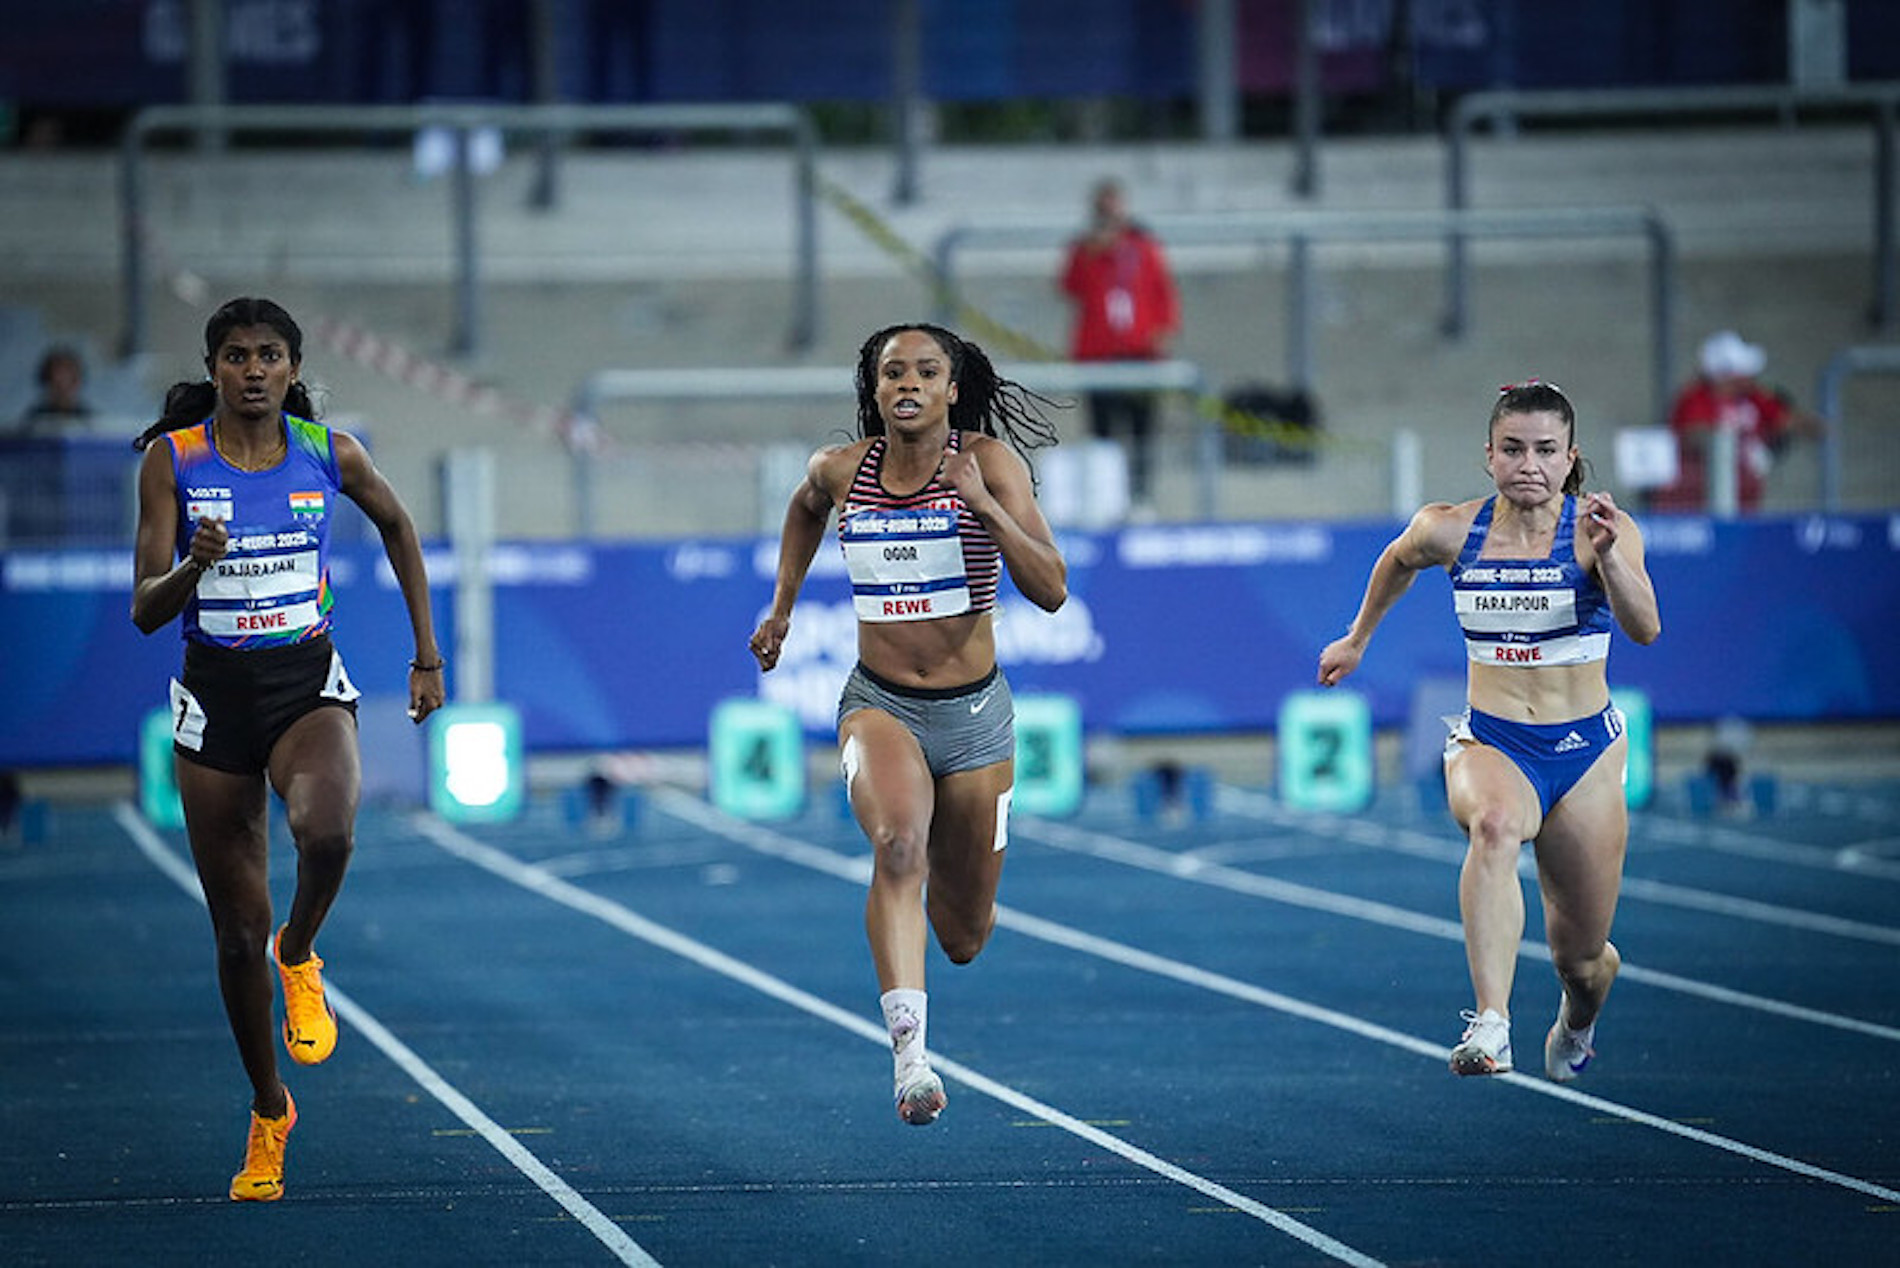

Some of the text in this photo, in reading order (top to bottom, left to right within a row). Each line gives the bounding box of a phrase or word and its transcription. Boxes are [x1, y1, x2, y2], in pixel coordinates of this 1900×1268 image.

[187, 487, 232, 498] VATS
[919, 516, 949, 531] 2025
[277, 531, 307, 548] 2025
[883, 546, 919, 561] OGOR
[217, 558, 296, 577] RAJARAJAN
[1531, 567, 1563, 583] 2025
[883, 598, 932, 616] REWE
[1474, 596, 1550, 612] FARAJPOUR
[236, 612, 288, 630] REWE
[1495, 646, 1542, 662] REWE
[740, 734, 774, 783] 4
[1307, 726, 1342, 778] 2
